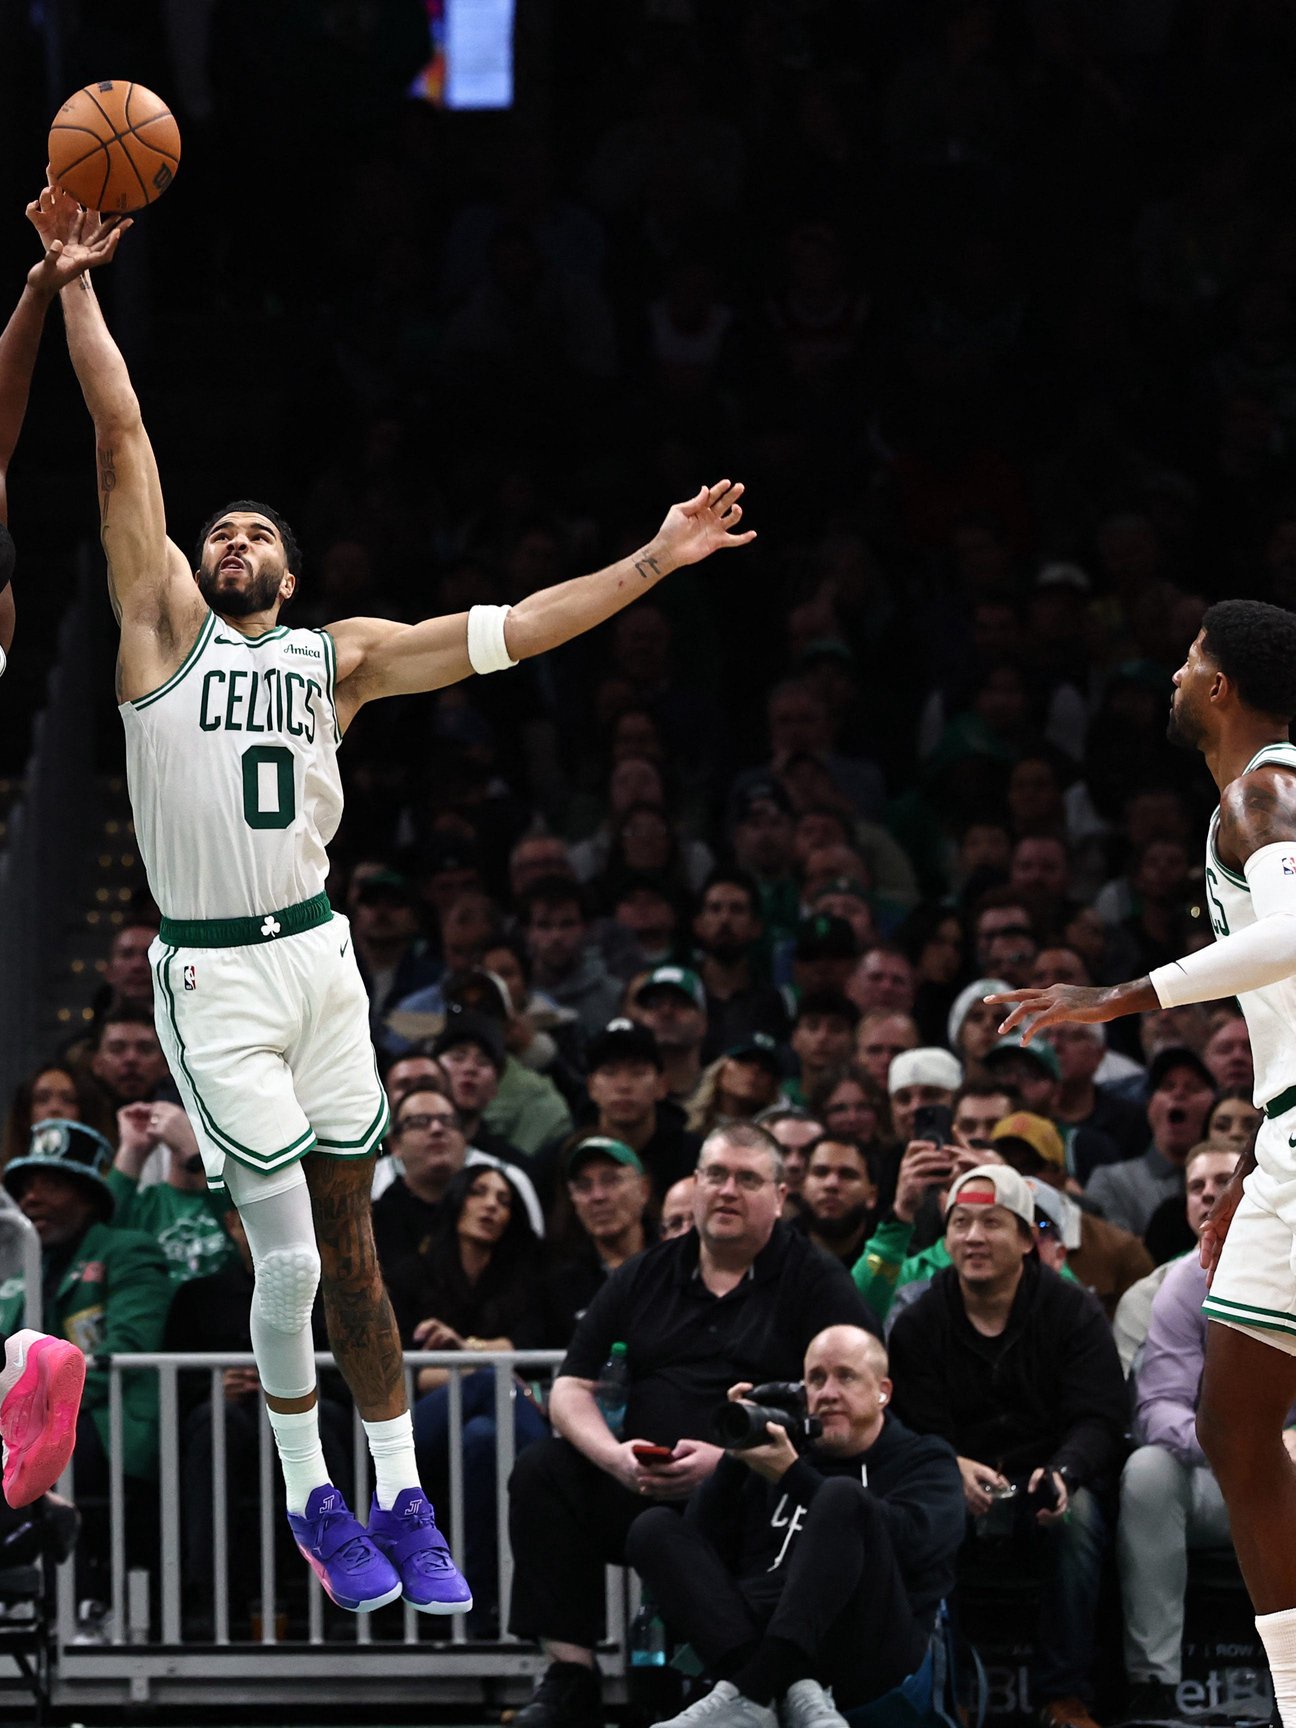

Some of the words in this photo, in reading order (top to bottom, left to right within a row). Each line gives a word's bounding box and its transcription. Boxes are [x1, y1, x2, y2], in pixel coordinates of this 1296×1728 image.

[283, 643, 321, 659] Amica
[199, 668, 322, 744] CELTICS
[241, 745, 295, 829] 0
